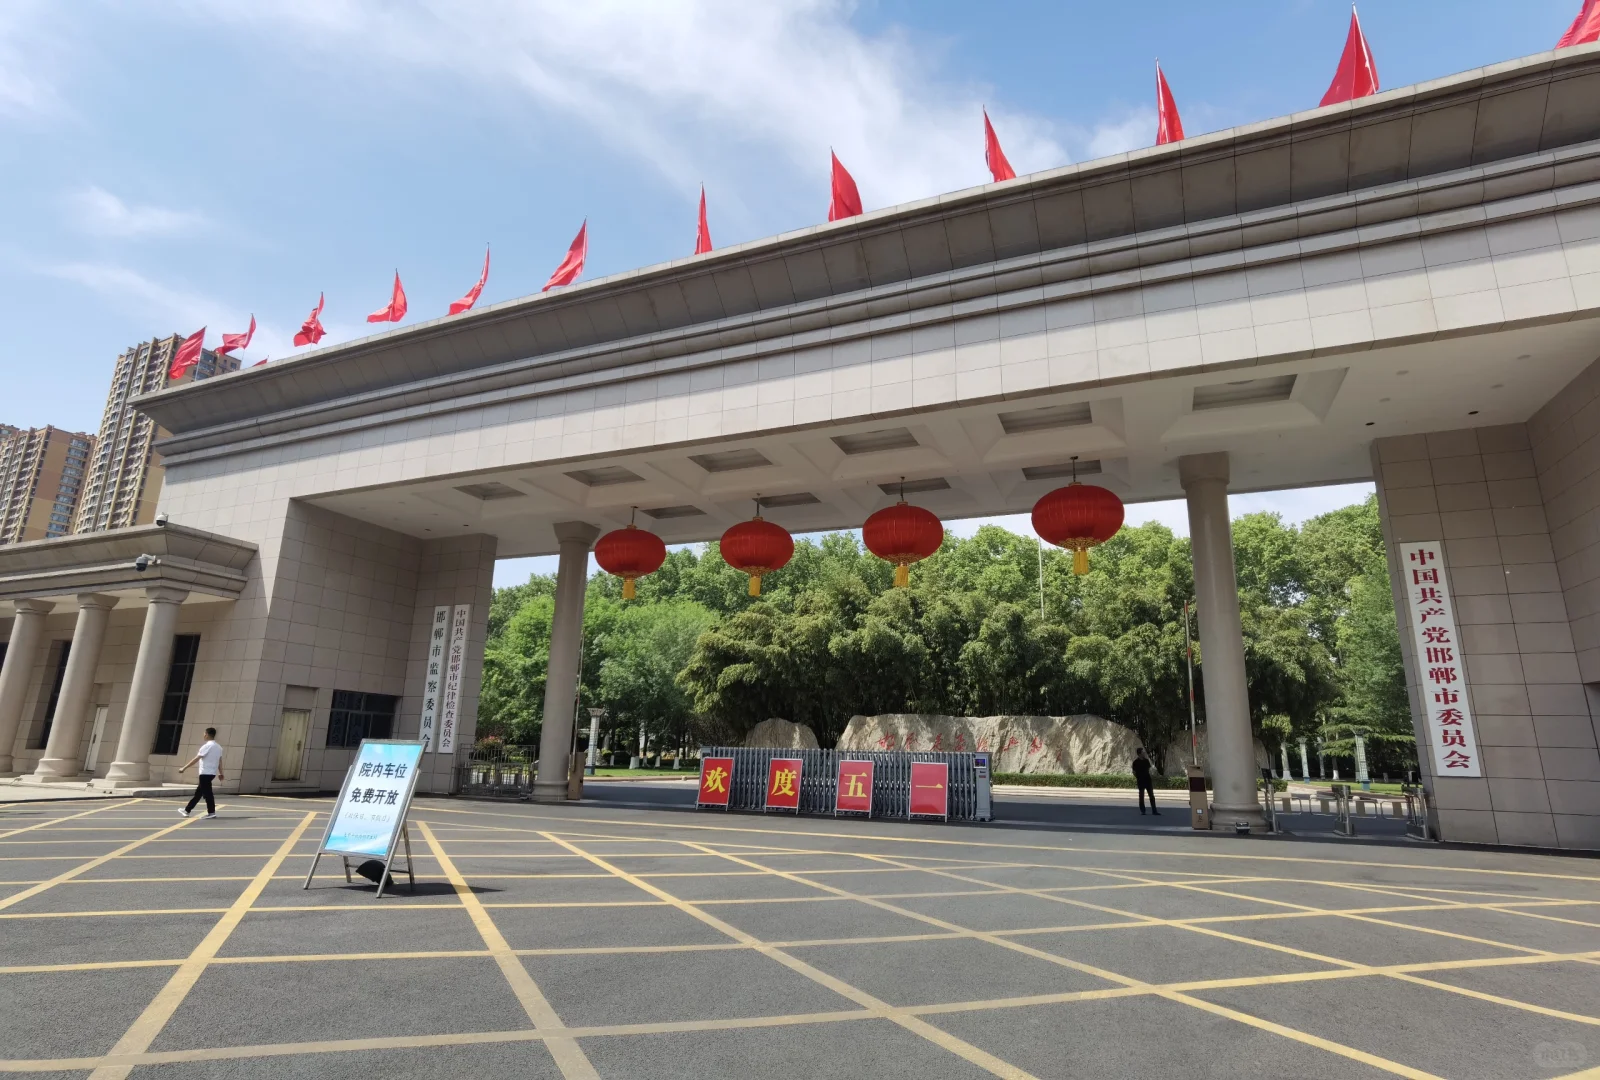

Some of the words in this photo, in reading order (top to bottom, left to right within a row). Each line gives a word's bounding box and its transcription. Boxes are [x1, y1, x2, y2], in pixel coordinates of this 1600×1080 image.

[441, 609, 467, 748] 中国共产党邯郸市纪律检查委员会
[1409, 548, 1472, 770] 中国共产党邯郸市委员会
[349, 787, 400, 805] 免费开放
[358, 762, 408, 778] 院内车位
